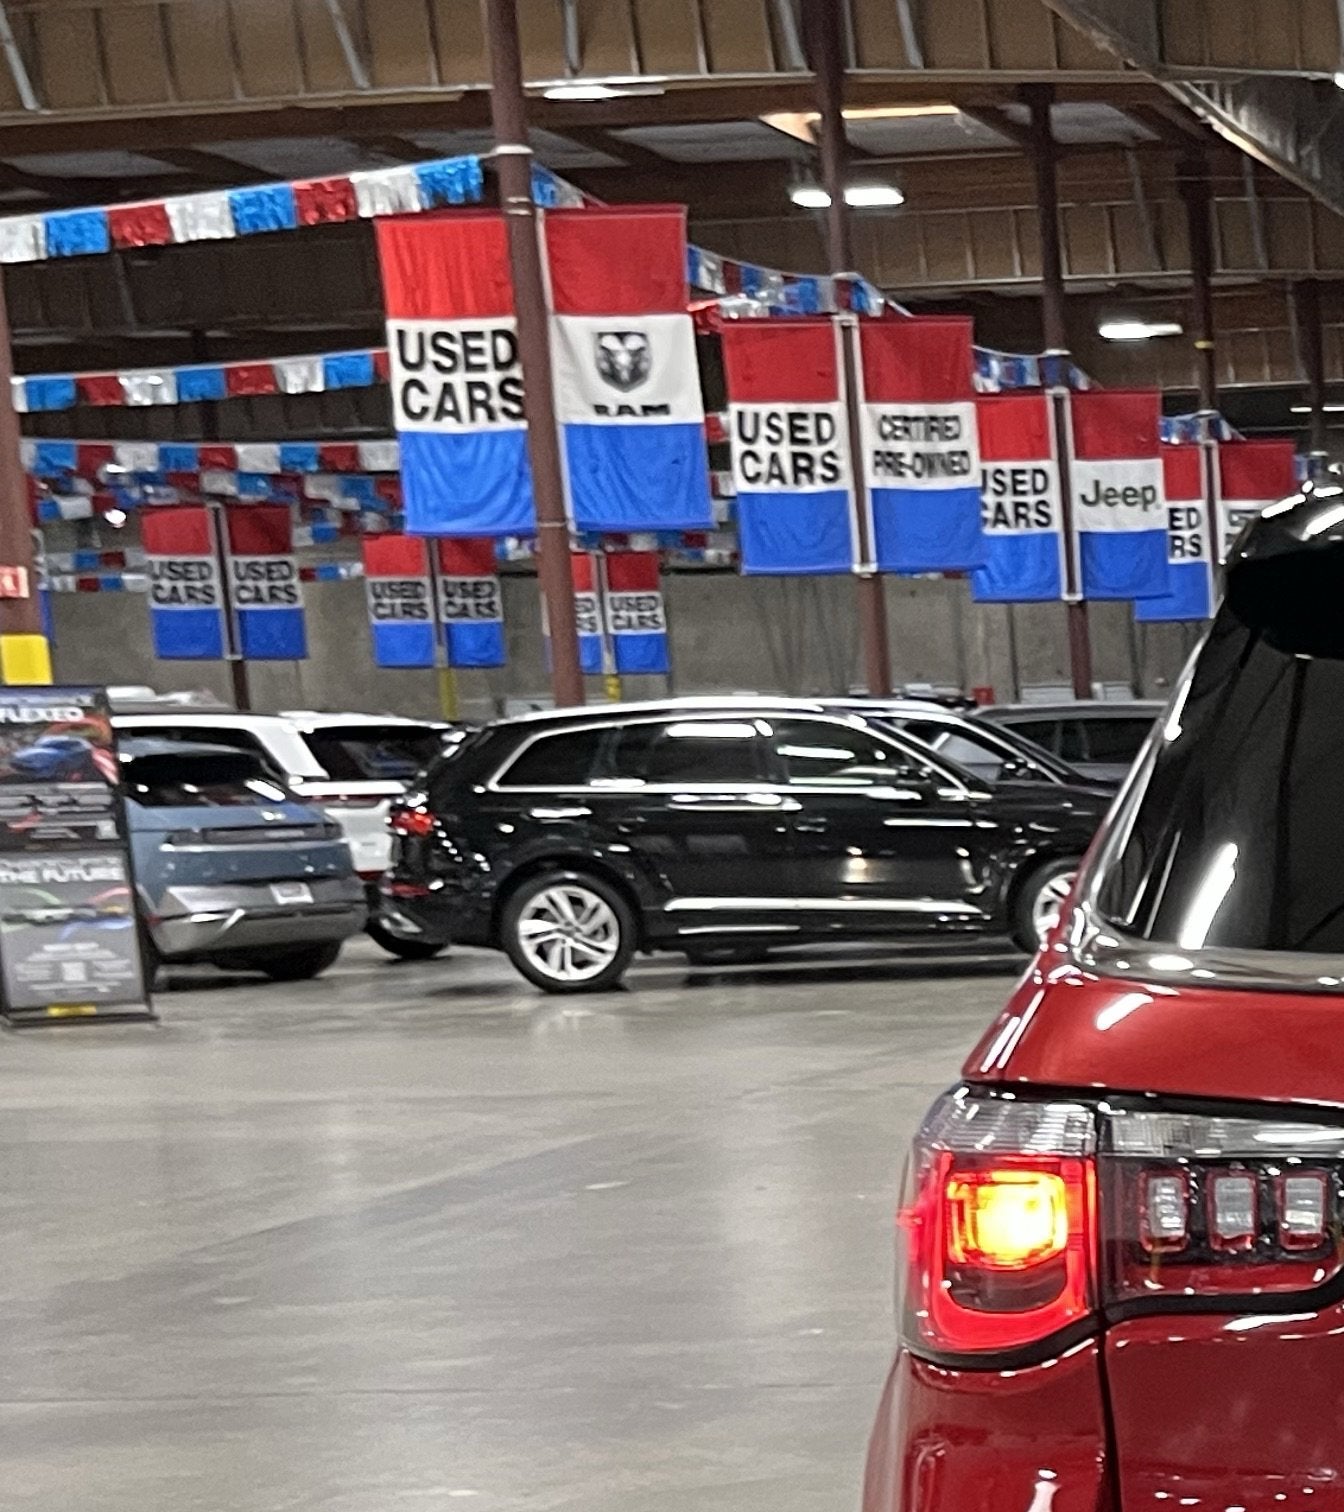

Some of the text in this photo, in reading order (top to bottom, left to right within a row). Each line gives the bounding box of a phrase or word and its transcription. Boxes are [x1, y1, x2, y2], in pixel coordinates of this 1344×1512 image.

[397, 329, 520, 374] USED
[402, 377, 525, 423] CARS
[593, 403, 671, 417] RAM
[737, 411, 836, 445] USED
[740, 450, 840, 485] CARS
[1081, 480, 1157, 512] Jeep
[981, 499, 1053, 529] ARS
[1168, 507, 1202, 531] ED
[1169, 534, 1202, 558] RS
[149, 561, 213, 581] USED
[234, 561, 295, 581] USED
[152, 584, 216, 604] CARS
[235, 584, 298, 604] CARS
[443, 580, 497, 598] USED
